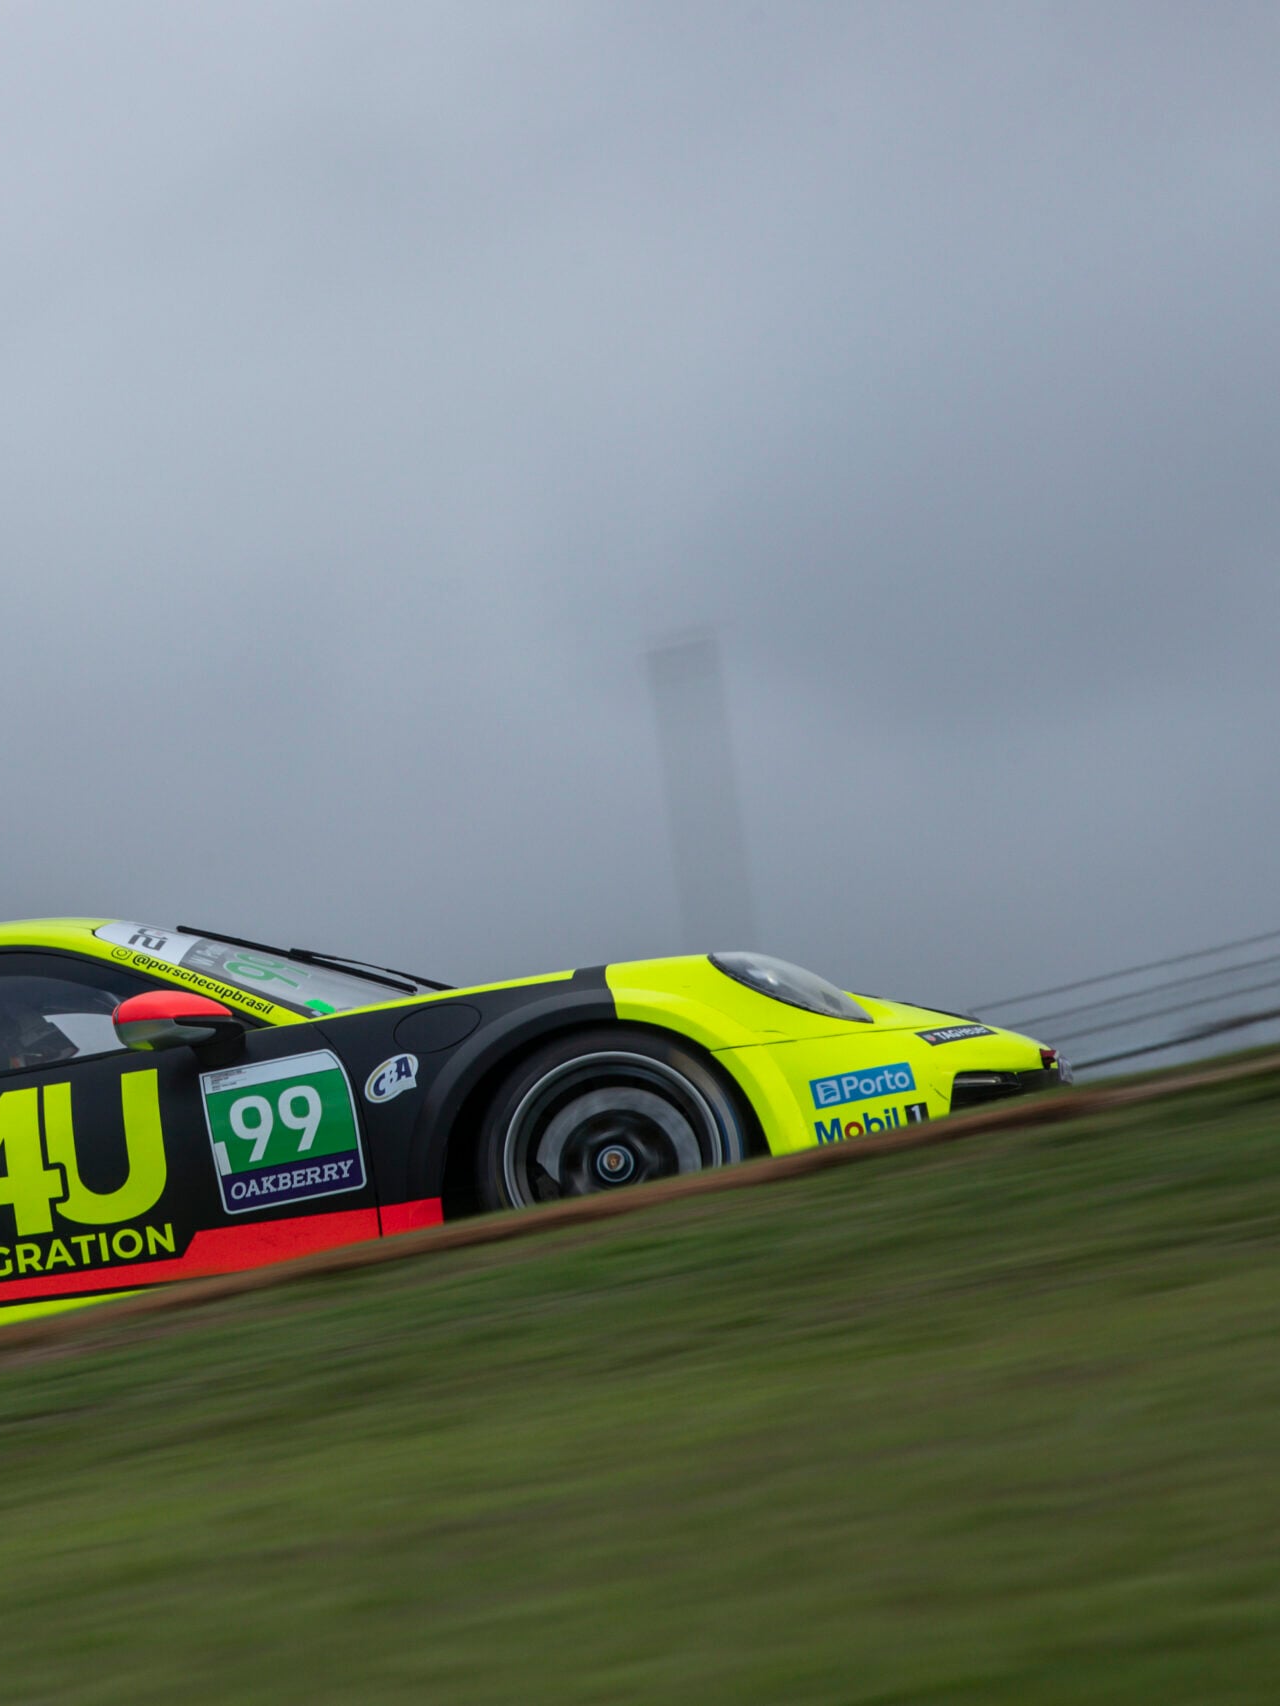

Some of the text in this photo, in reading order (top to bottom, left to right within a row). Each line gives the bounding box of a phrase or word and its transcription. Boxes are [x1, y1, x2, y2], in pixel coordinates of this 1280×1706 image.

[132, 954, 276, 1016] @porschecupbrasil
[223, 952, 311, 990] 99
[373, 1056, 412, 1097] CBA
[841, 1070, 910, 1099] Porto
[229, 1085, 322, 1163] 99
[814, 1105, 923, 1145] Mobil 1
[231, 1160, 353, 1200] OAKBERRY
